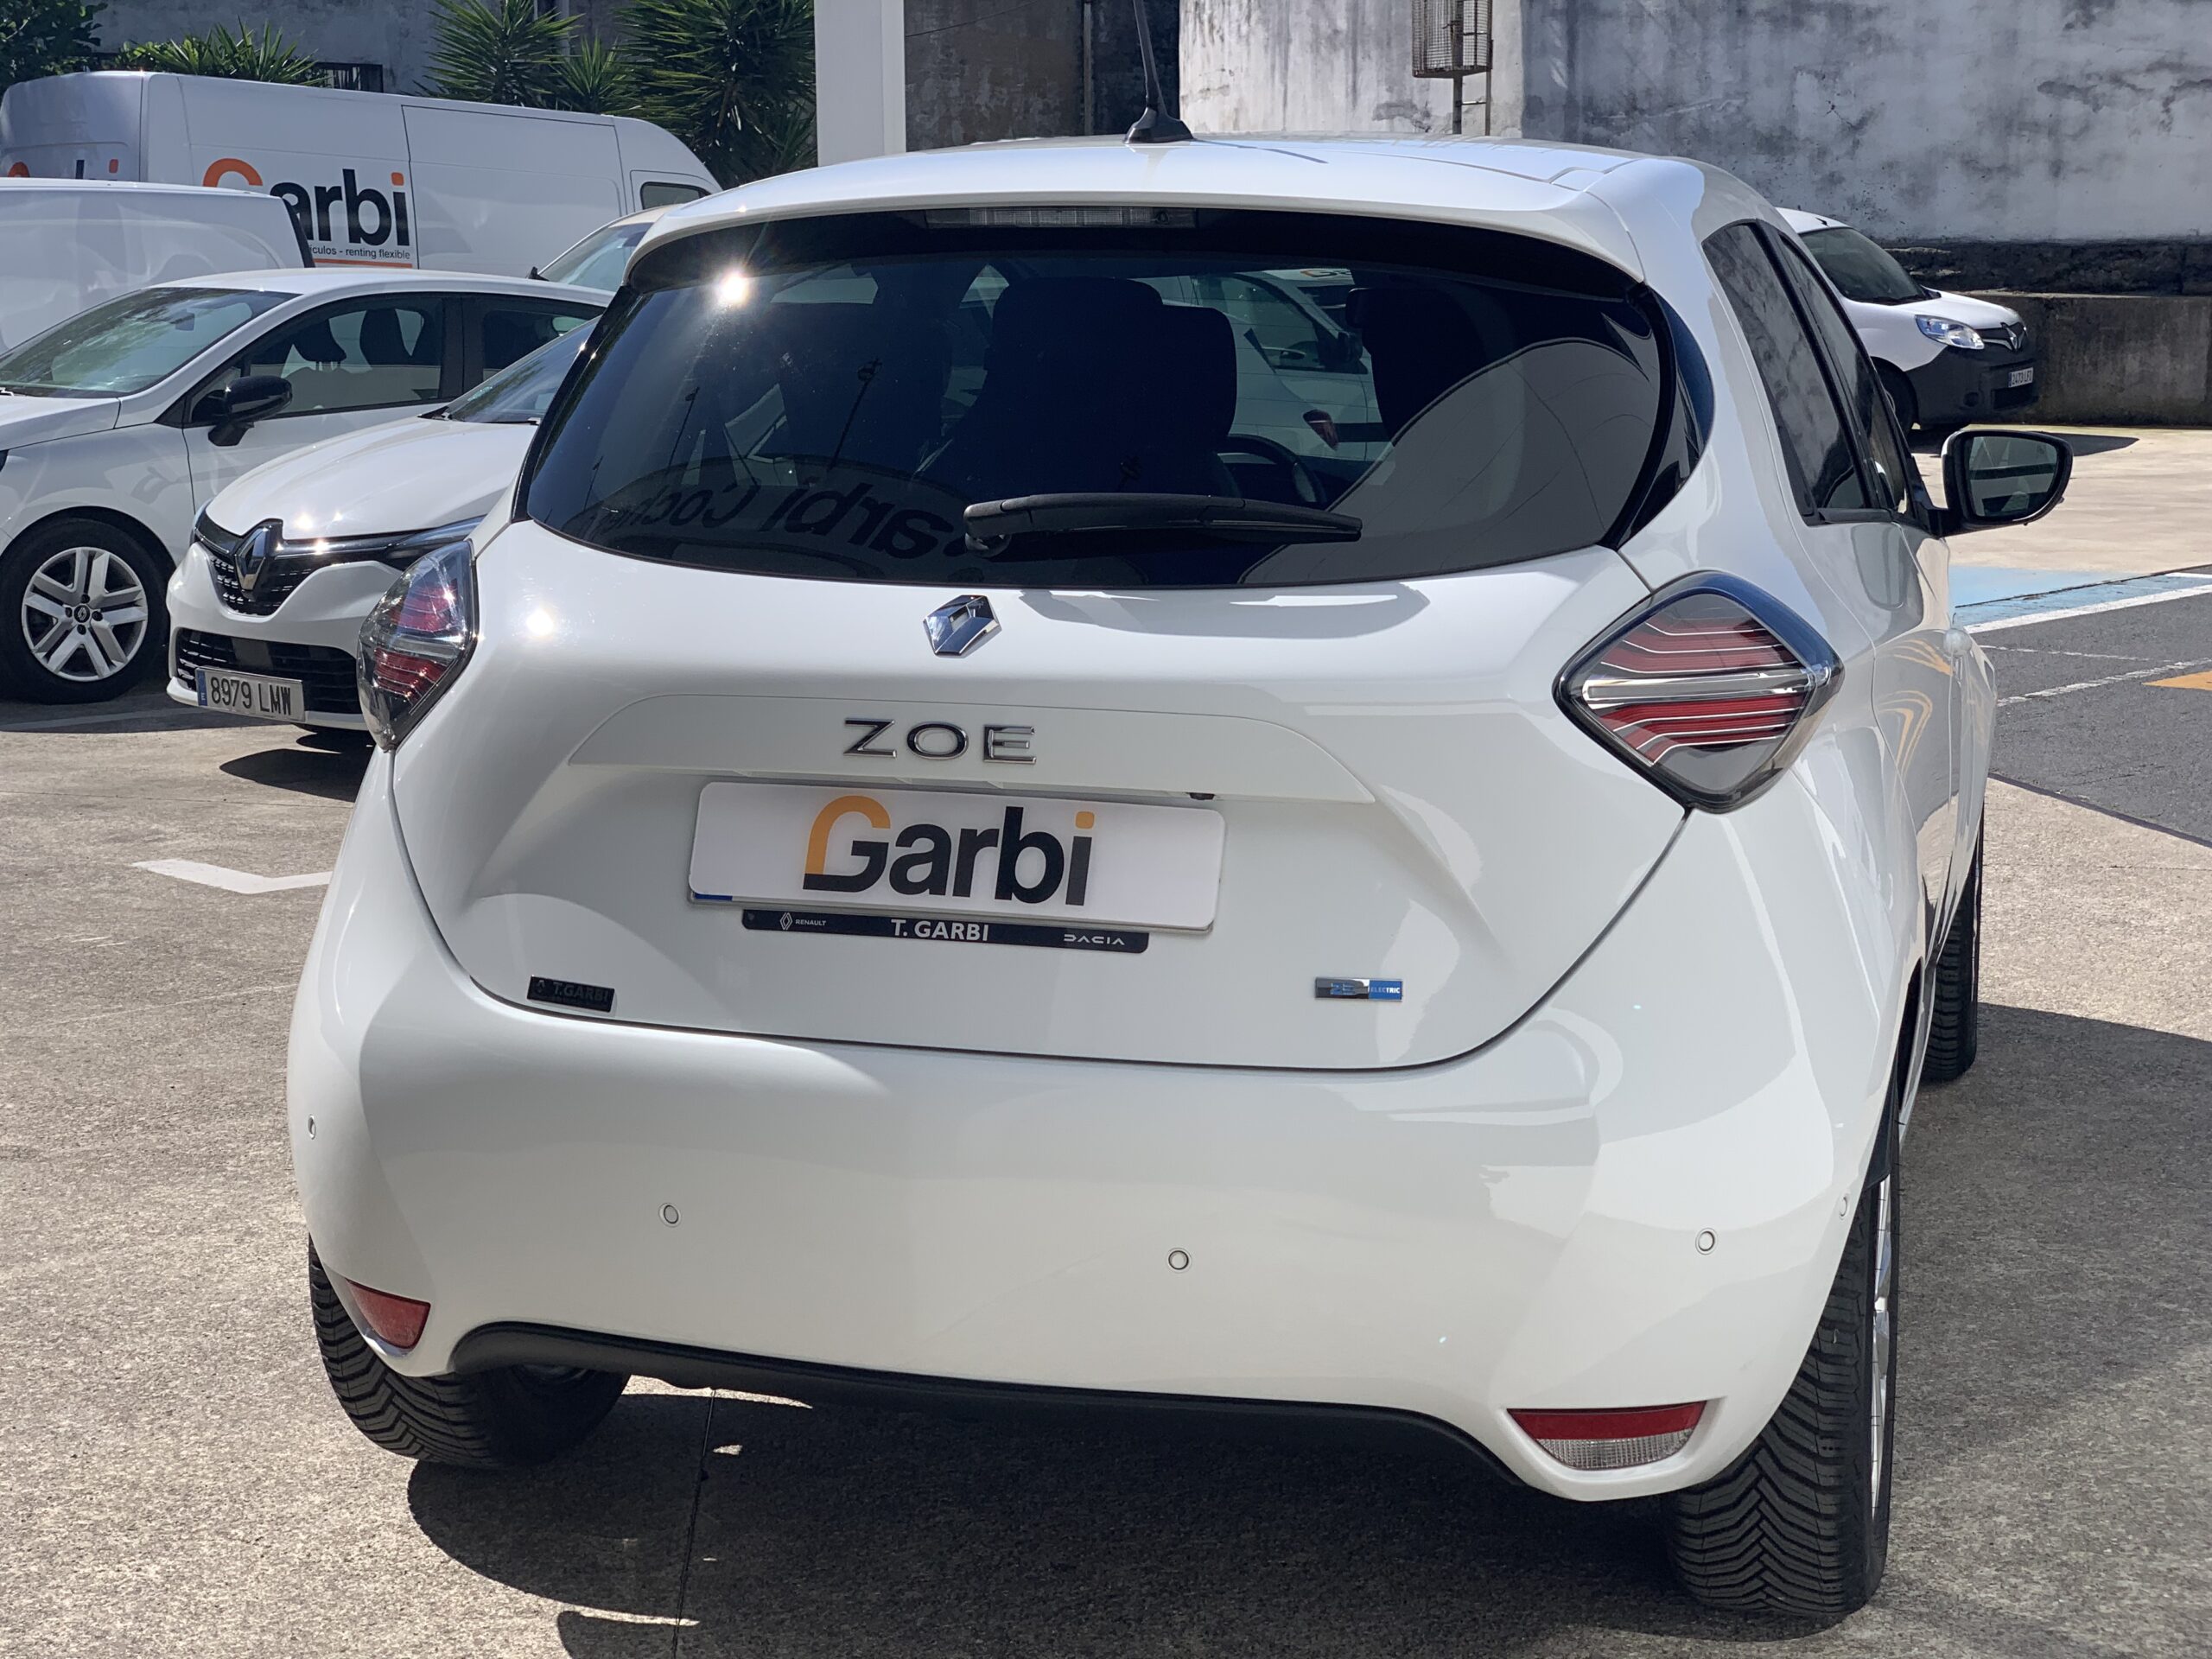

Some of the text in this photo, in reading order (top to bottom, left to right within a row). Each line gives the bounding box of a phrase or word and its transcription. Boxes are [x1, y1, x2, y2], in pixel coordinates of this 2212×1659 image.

[203, 158, 410, 246] arbi
[346, 248, 377, 259] renting
[378, 248, 410, 259] flexible
[210, 677, 291, 715] 8979 LMW
[843, 718, 1036, 764] ZOE
[803, 795, 1095, 906] Garbi
[891, 918, 988, 942] T. GARBI
[1064, 934, 1125, 946] DACIA
